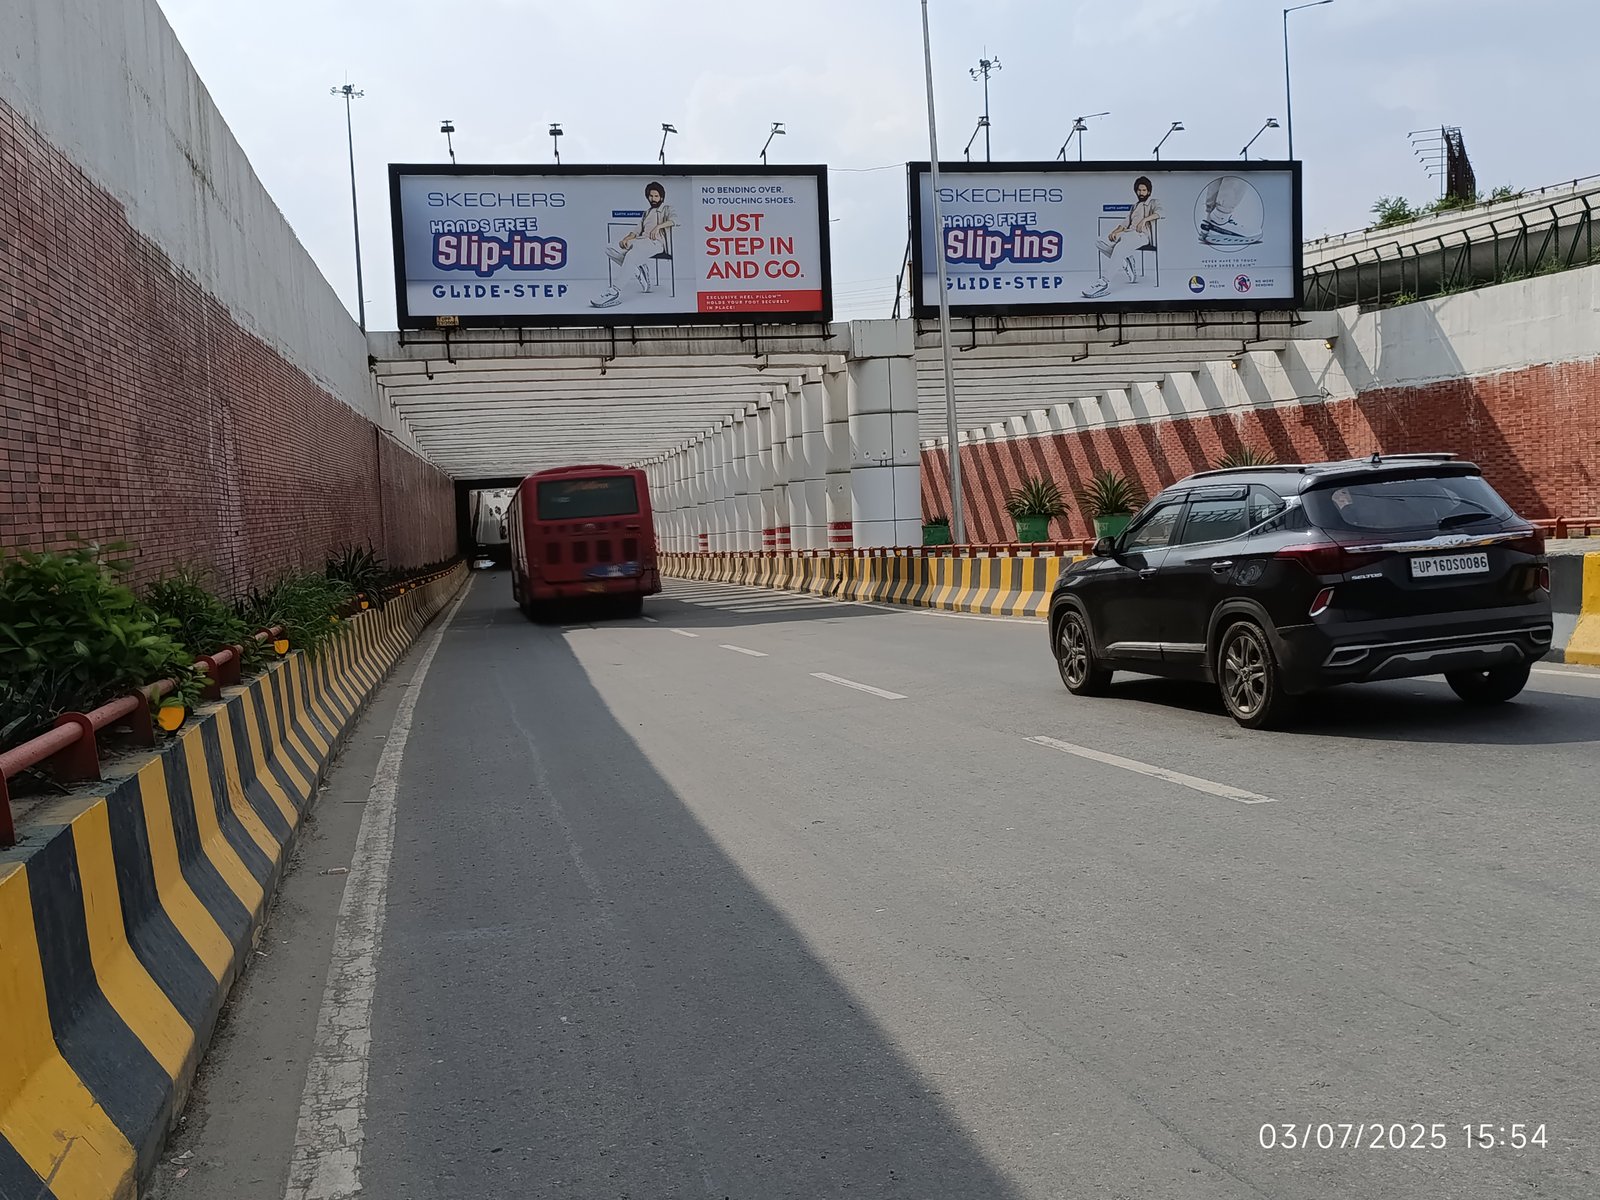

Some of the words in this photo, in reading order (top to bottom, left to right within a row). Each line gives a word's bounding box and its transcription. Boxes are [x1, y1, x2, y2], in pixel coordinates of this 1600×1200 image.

[428, 192, 566, 208] SKECHERS
[940, 188, 1063, 202] SKECHERS
[430, 219, 490, 234] HANDS
[494, 217, 538, 232] FREE
[704, 214, 764, 232] JUST
[997, 212, 1036, 226] FREE
[436, 233, 565, 273] Slip-ins
[706, 238, 764, 256] STEP
[770, 236, 794, 254] IN
[945, 229, 1060, 266] Slip-ins
[706, 261, 760, 279] AND
[764, 260, 804, 278] GO.
[432, 284, 568, 298] GLIDE-STEP
[1419, 557, 1488, 574] UP16DS0086
